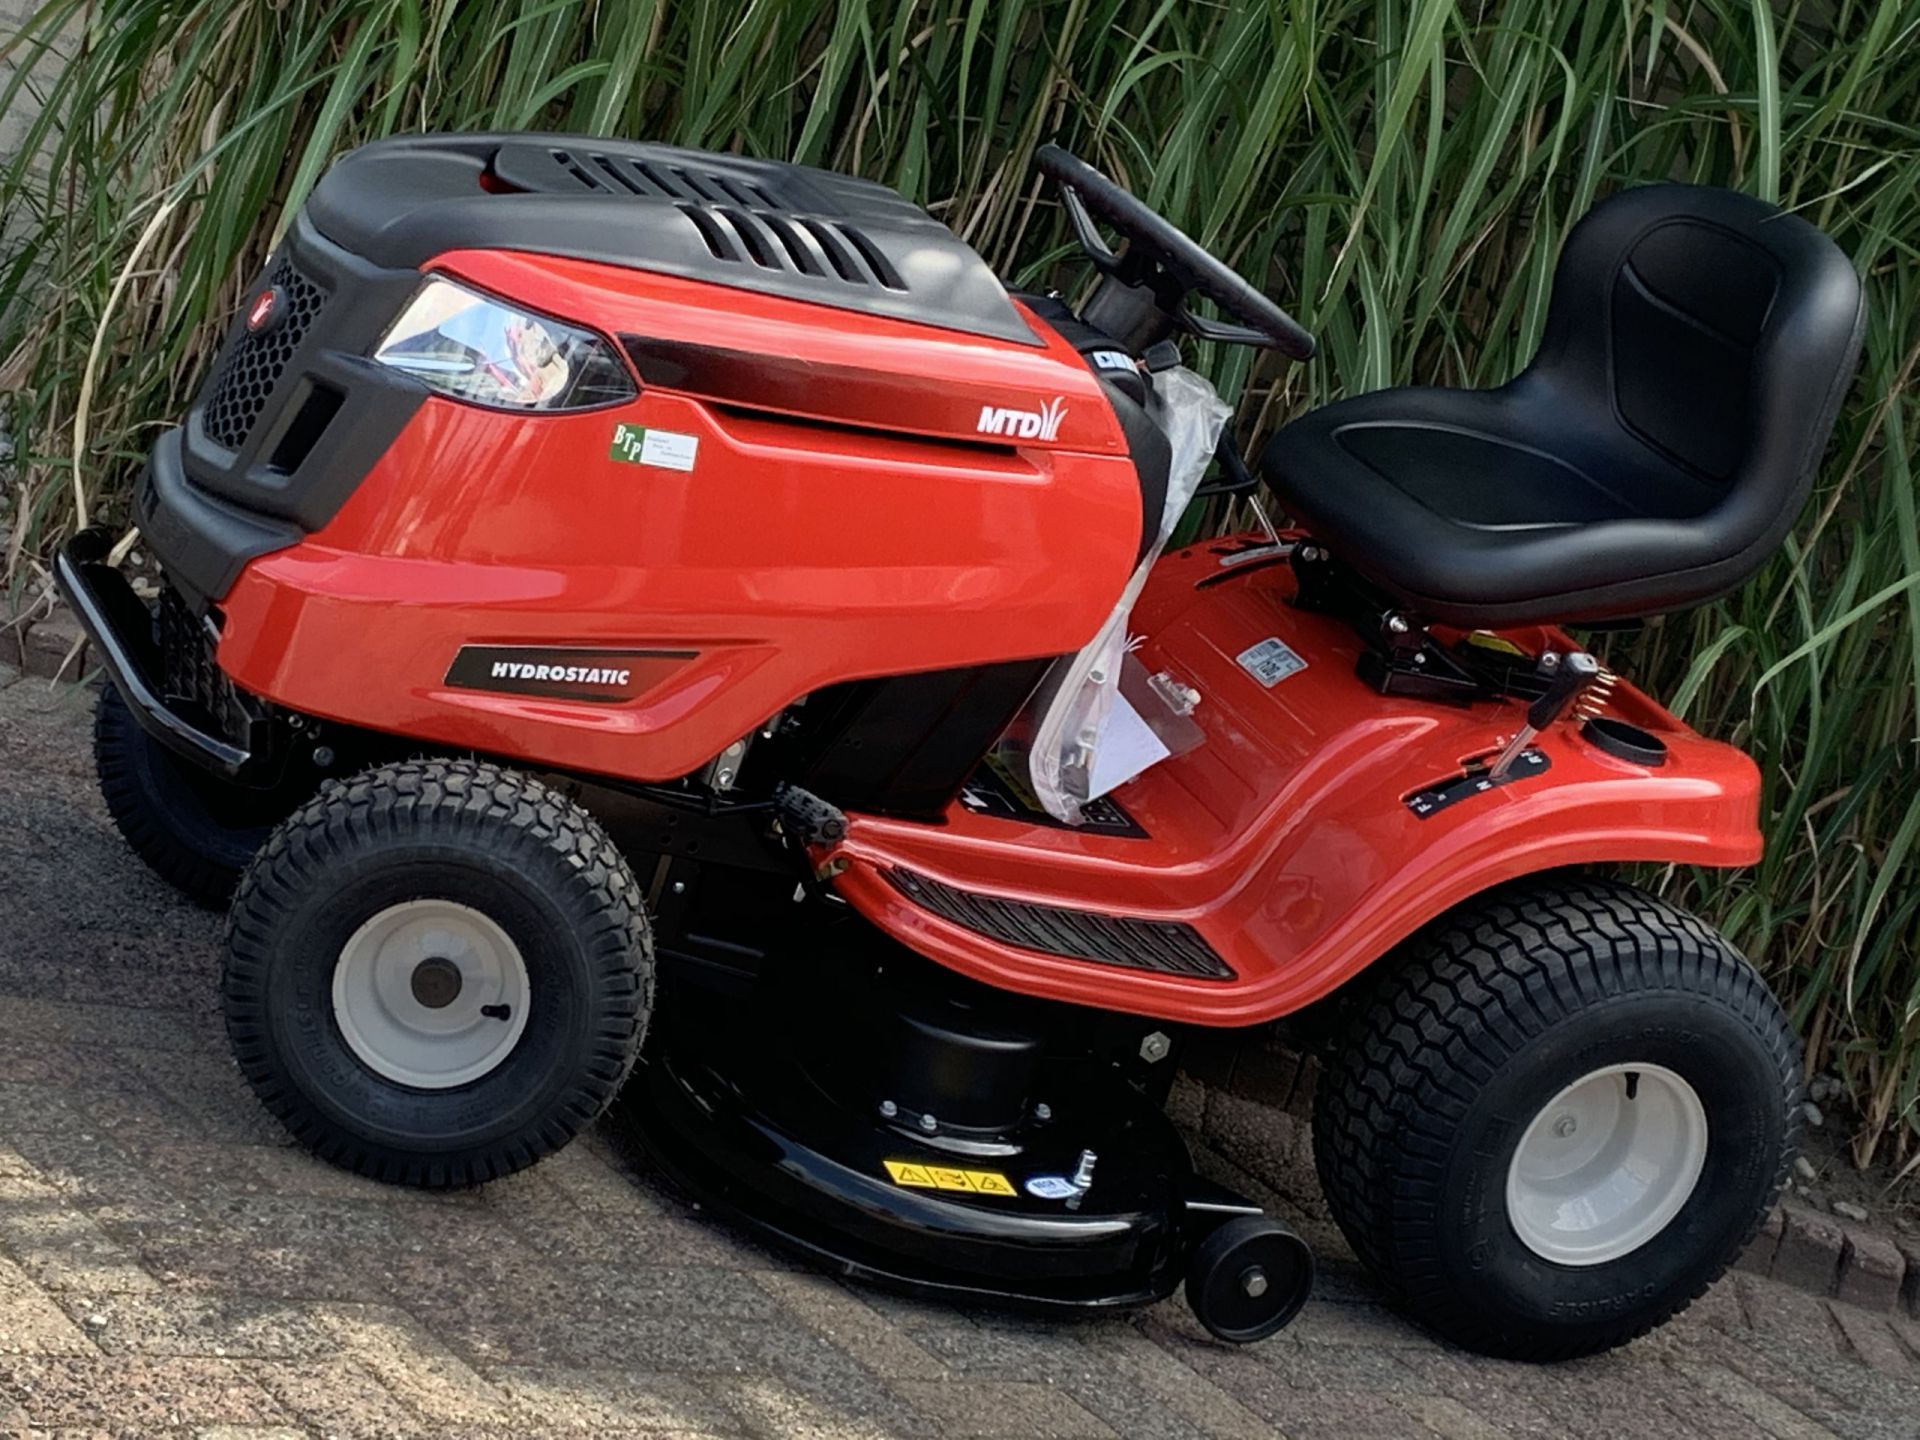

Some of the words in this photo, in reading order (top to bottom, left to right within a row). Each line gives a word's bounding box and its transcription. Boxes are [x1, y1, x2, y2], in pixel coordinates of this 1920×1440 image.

[977, 406, 1041, 438] MTD
[612, 424, 642, 461] BTP
[491, 661, 631, 686] HYDROSTATIC
[1417, 803, 1433, 813] F
